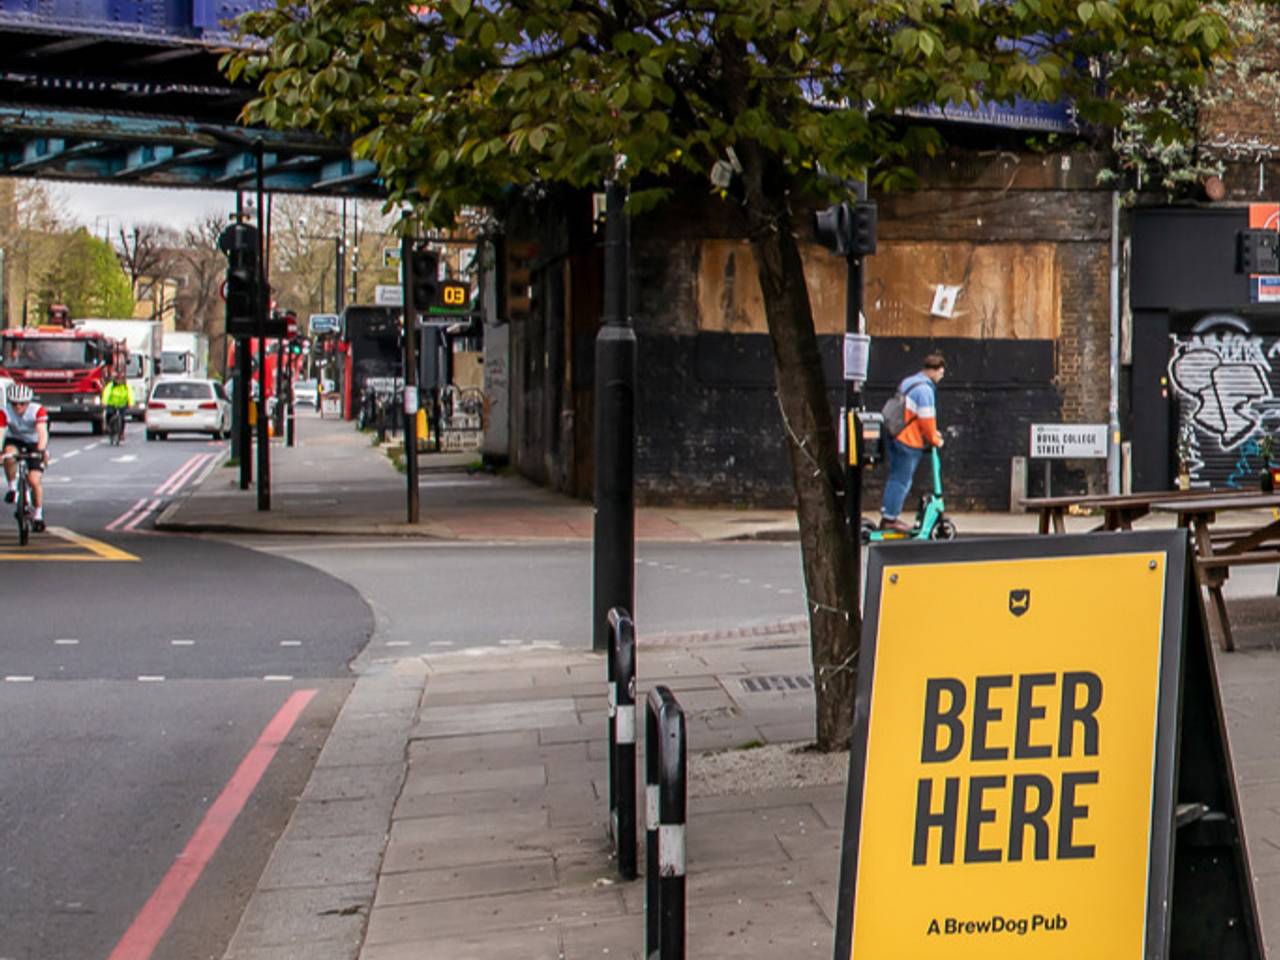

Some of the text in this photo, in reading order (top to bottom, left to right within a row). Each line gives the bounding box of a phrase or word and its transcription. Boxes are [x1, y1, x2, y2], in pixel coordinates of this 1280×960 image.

[443, 286, 465, 304] 03
[1037, 433, 1097, 444] ROYAL COLLEGE
[1037, 445, 1065, 455] STREET
[920, 670, 1104, 764] BEER
[911, 771, 1100, 867] HERE
[927, 913, 1068, 936] A BrewDog Pub
